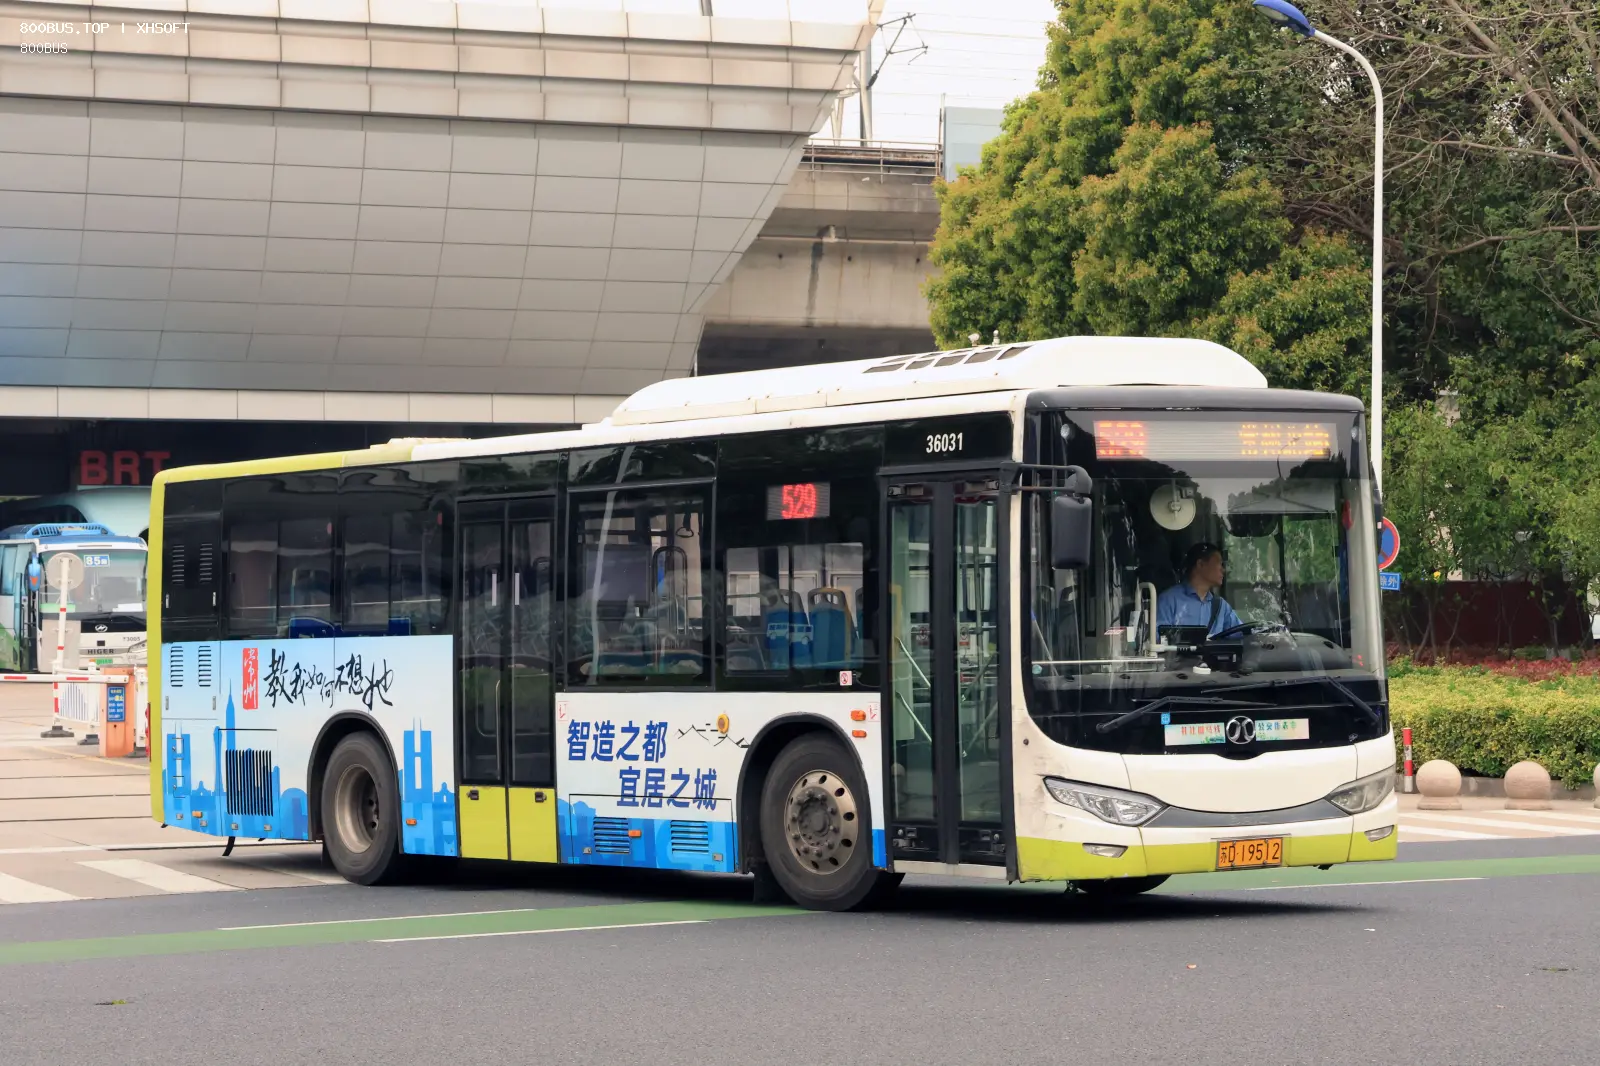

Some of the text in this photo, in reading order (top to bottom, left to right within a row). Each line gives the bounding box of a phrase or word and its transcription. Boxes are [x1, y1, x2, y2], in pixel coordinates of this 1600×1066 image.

[926, 432, 963, 454] 36031
[80, 450, 171, 485] BRT
[781, 483, 817, 519] 529
[85, 556, 108, 566] 85
[243, 648, 258, 709] 常州
[263, 648, 394, 710] 教我如何不想她
[567, 719, 668, 763] 智造之都
[616, 766, 718, 811] 宜居之城
